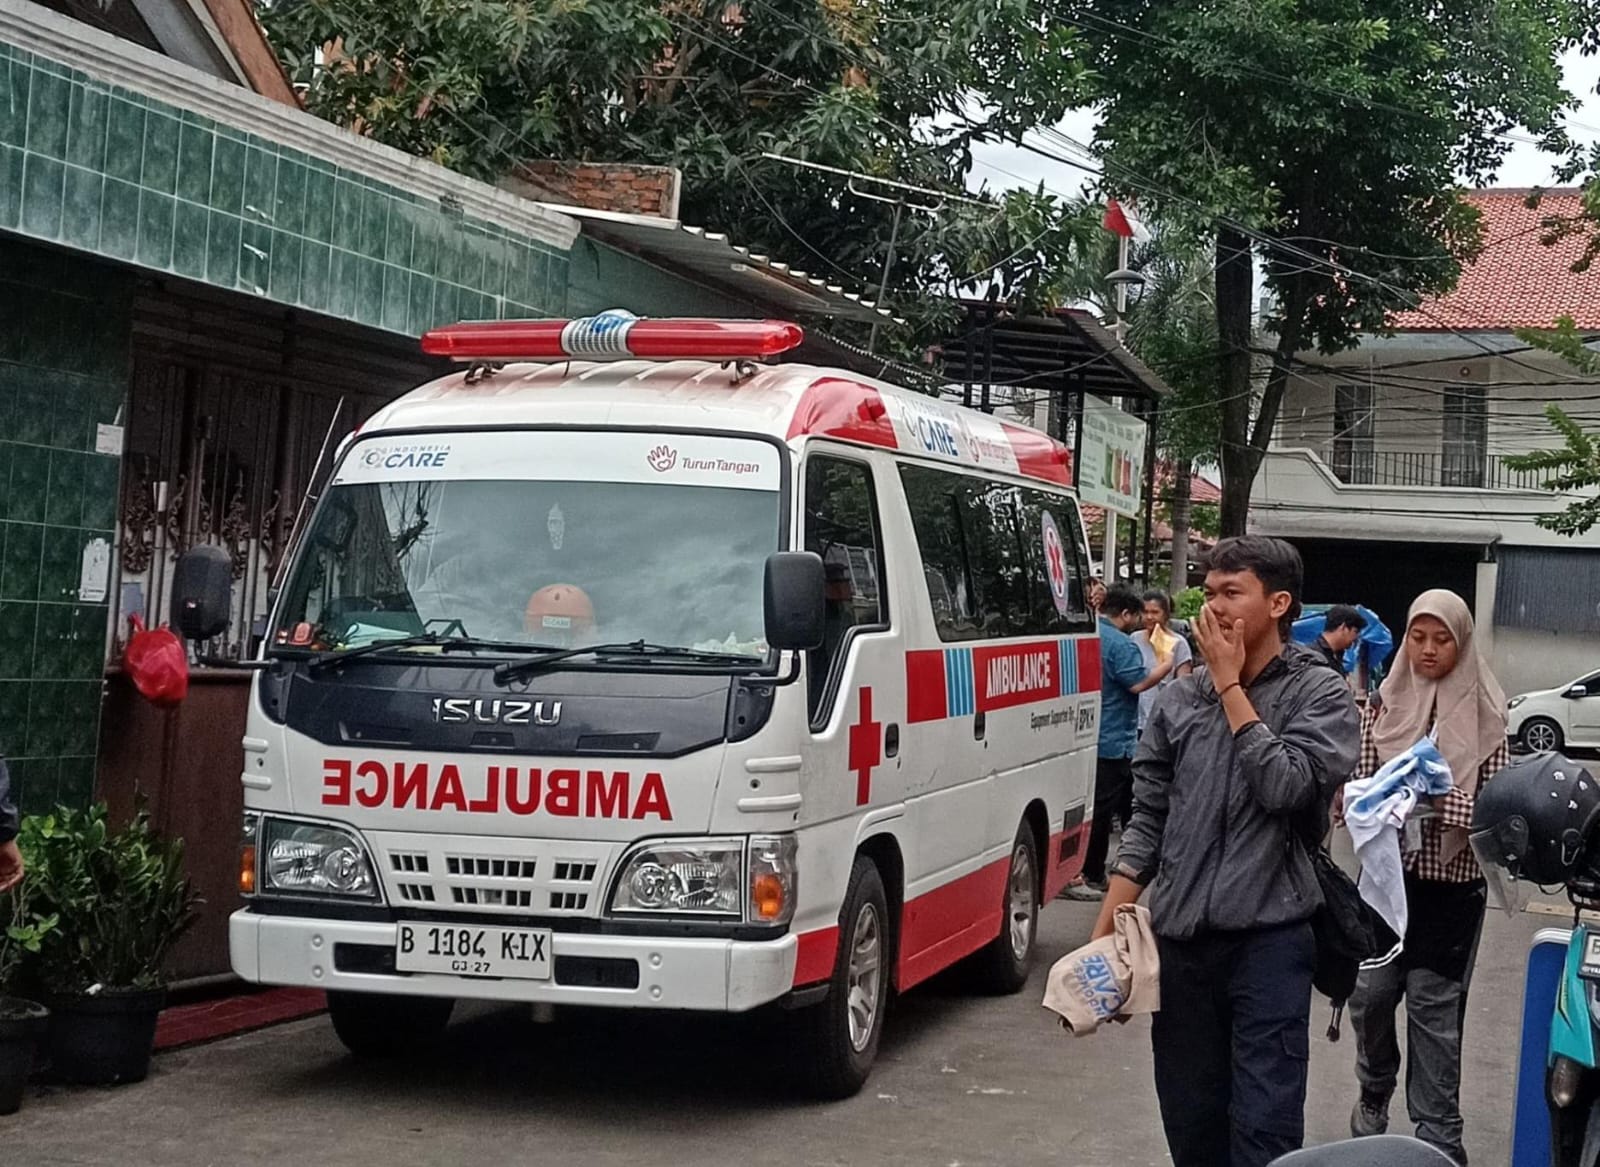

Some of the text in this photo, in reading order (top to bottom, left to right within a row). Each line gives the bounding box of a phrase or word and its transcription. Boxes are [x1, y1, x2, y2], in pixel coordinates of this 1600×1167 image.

[918, 416, 959, 456] CARE
[384, 452, 449, 469] CARE
[986, 652, 1051, 699] AMBULANCE
[432, 699, 562, 725] ISUZU
[401, 926, 546, 961] B 1184 KIX
[1081, 955, 1122, 1013] CARE
